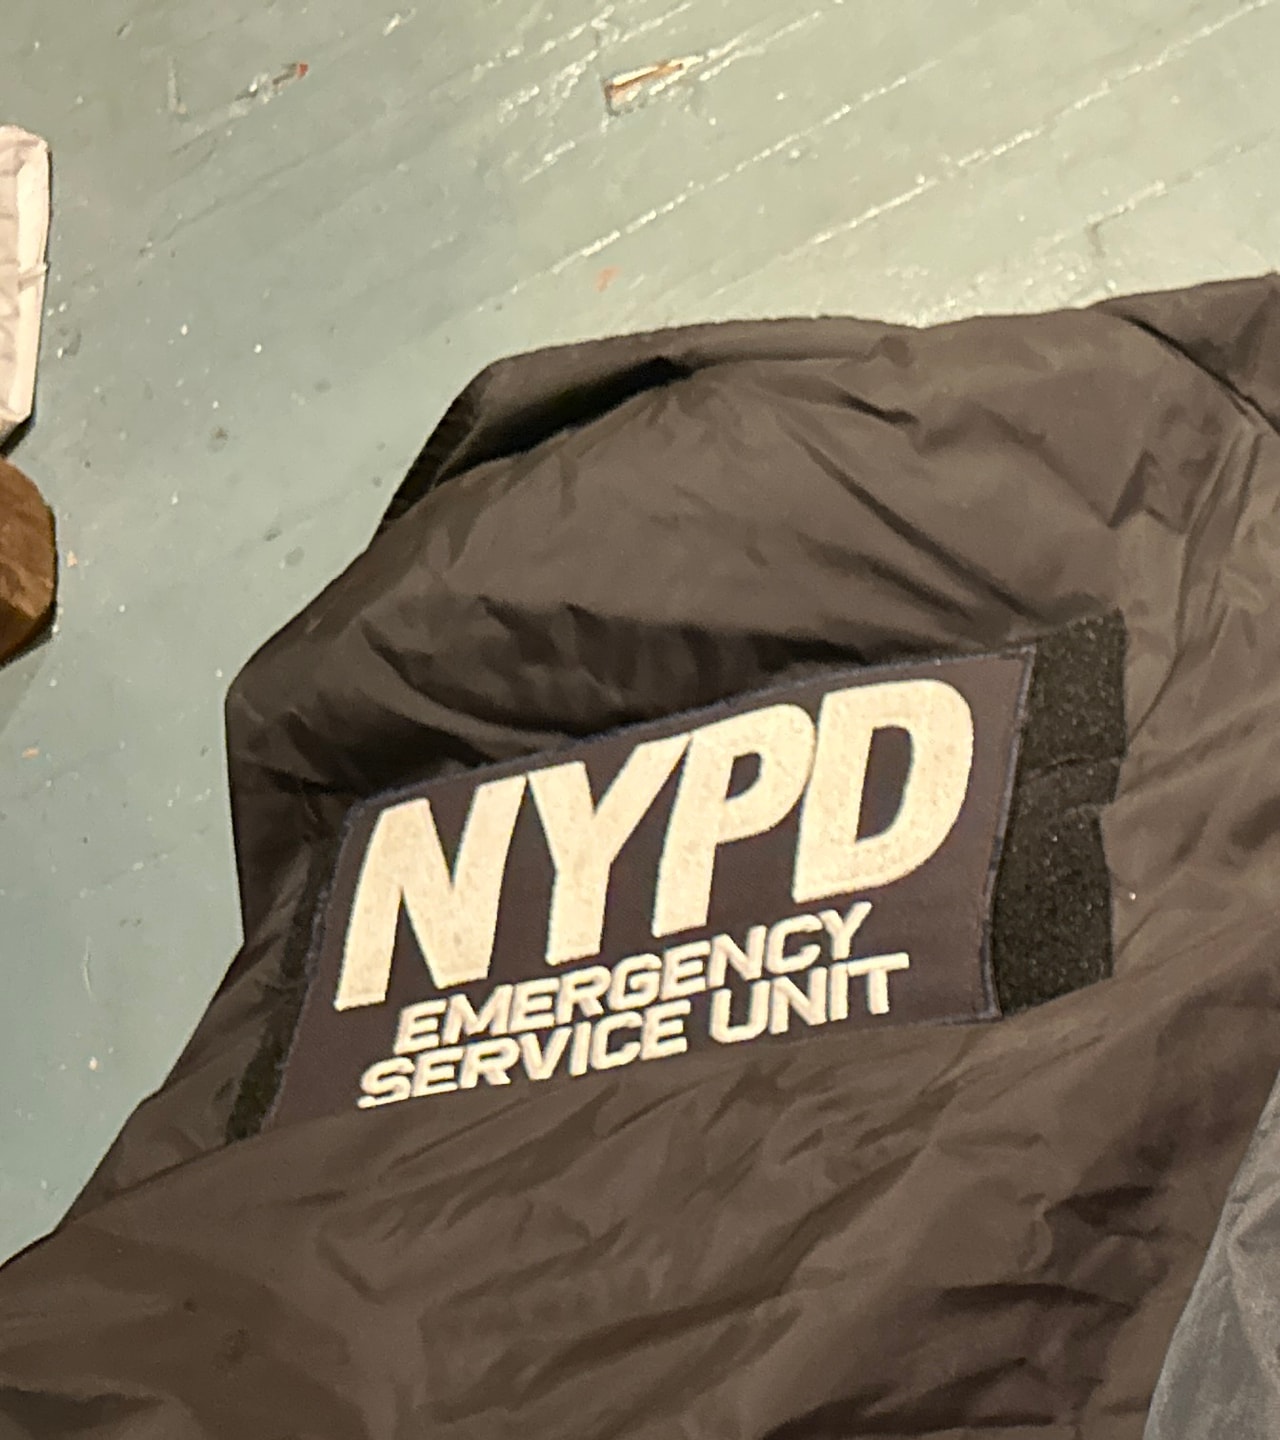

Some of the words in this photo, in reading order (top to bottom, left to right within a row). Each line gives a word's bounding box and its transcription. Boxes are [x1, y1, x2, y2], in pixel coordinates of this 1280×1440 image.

[333, 677, 974, 1011] NYPD
[357, 1001, 691, 1109] SERVICE
[708, 952, 909, 1044] UNIT
[393, 901, 874, 1056] EMERGENCY
